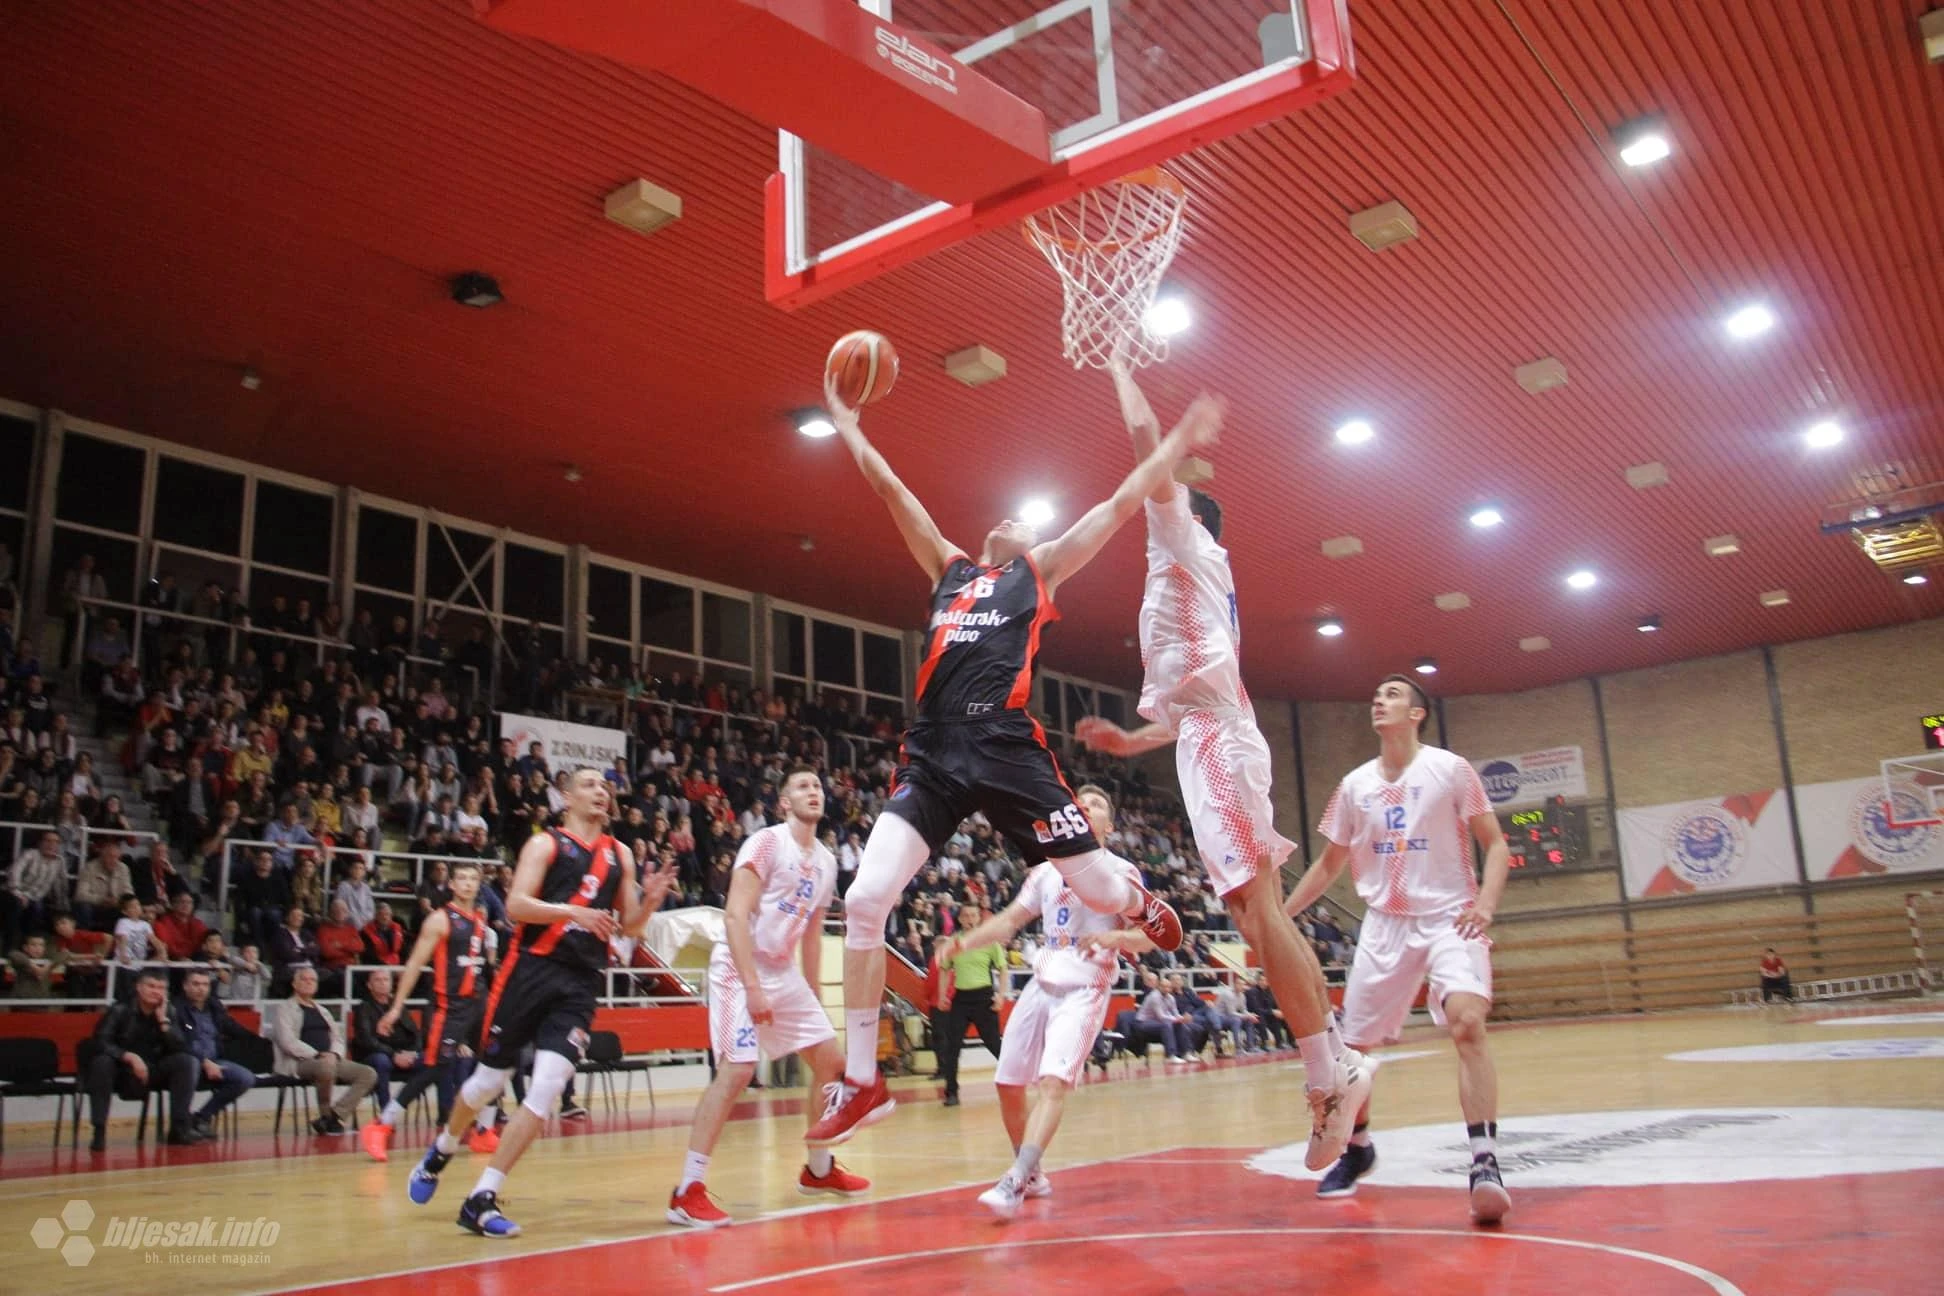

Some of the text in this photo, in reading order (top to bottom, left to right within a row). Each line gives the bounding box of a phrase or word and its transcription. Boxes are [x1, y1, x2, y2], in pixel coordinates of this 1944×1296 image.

[874, 26, 956, 82] elan
[941, 627, 981, 648] pivo
[1050, 803, 1089, 839] 46
[1384, 806, 1406, 830] 12
[796, 878, 814, 898] 23
[1057, 907, 1069, 926] 8
